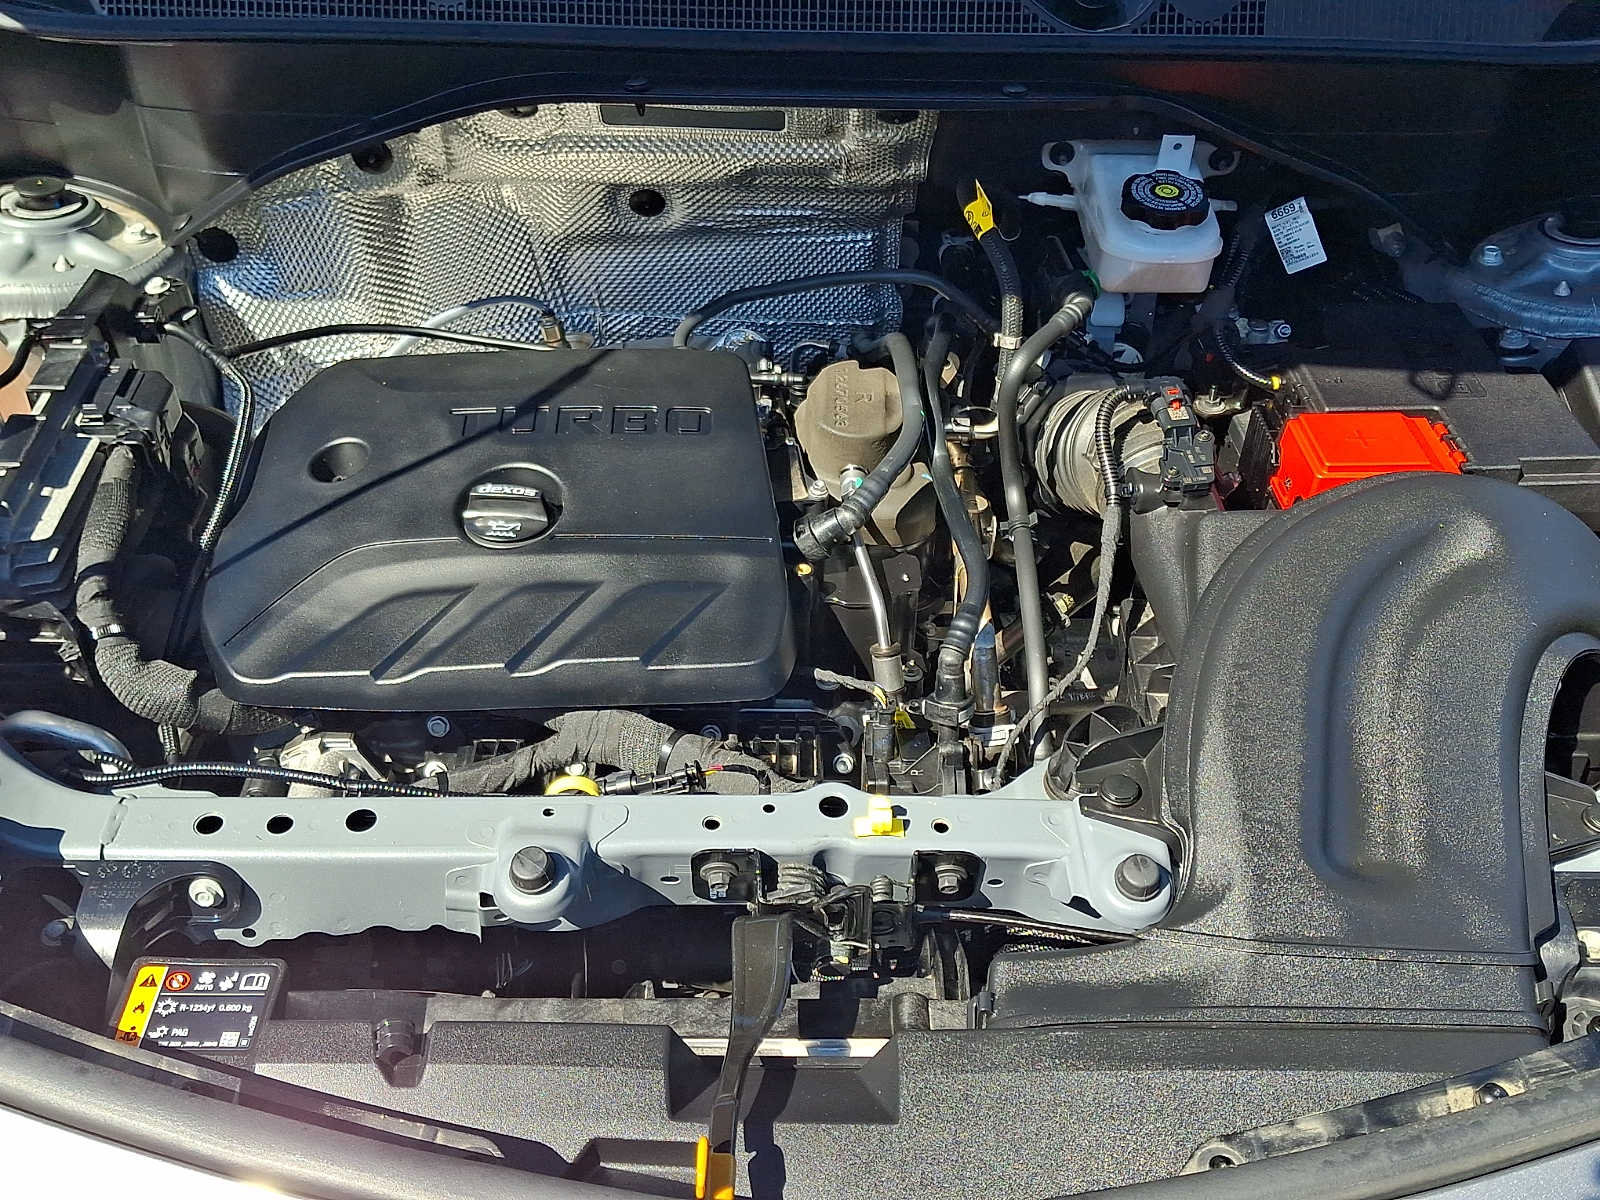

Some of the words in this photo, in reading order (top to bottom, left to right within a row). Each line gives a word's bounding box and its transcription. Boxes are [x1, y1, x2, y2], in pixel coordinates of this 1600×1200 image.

[1270, 203, 1296, 220] 6669
[450, 405, 713, 437] TURBO
[478, 483, 539, 497] dexos
[194, 983, 214, 991] AUTO
[180, 1003, 217, 1013] R-1234yf
[241, 1004, 253, 1013] kg
[170, 1028, 189, 1037] PAG
